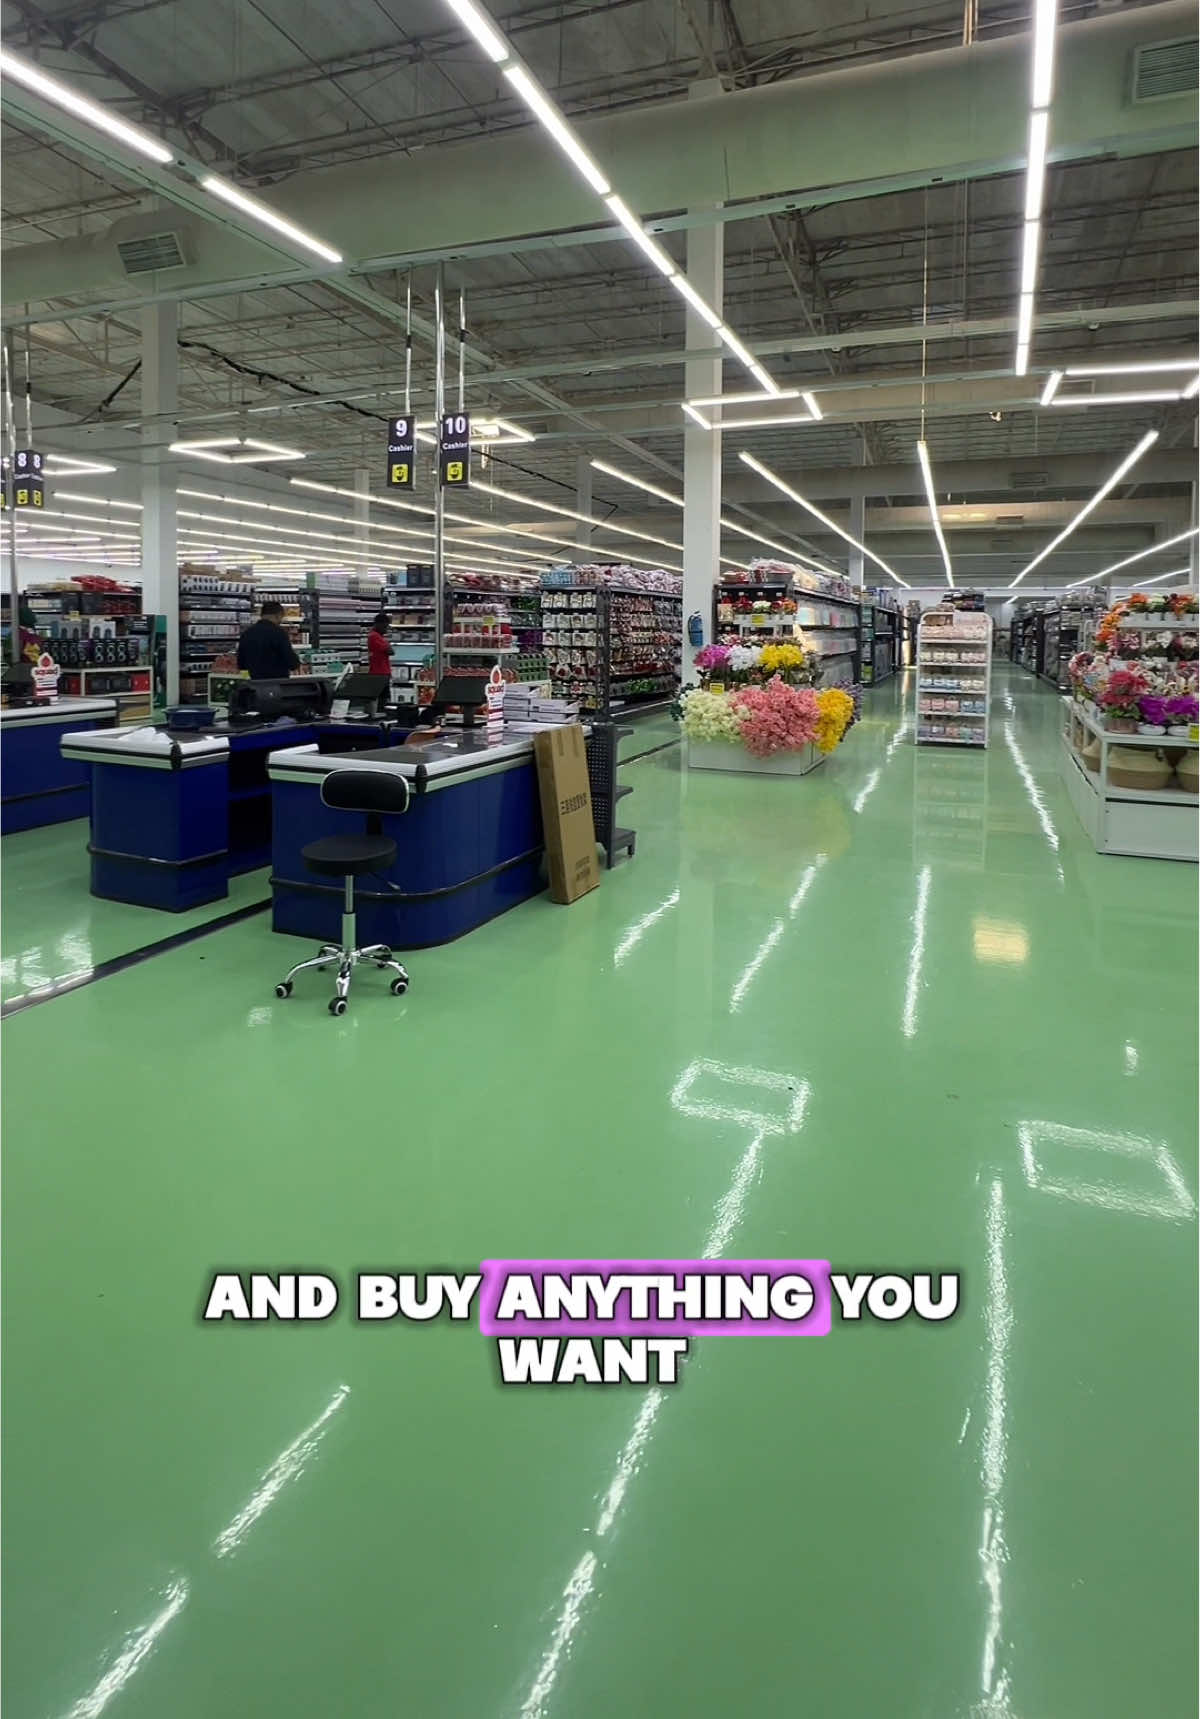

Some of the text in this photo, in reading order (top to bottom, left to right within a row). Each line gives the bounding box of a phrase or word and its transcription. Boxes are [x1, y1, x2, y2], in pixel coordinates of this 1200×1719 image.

[396, 419, 408, 437] 9
[445, 416, 466, 435] 10
[388, 443, 414, 452] Cashier
[442, 441, 468, 450] Cashier
[18, 453, 27, 467] 8
[33, 454, 41, 468] 8
